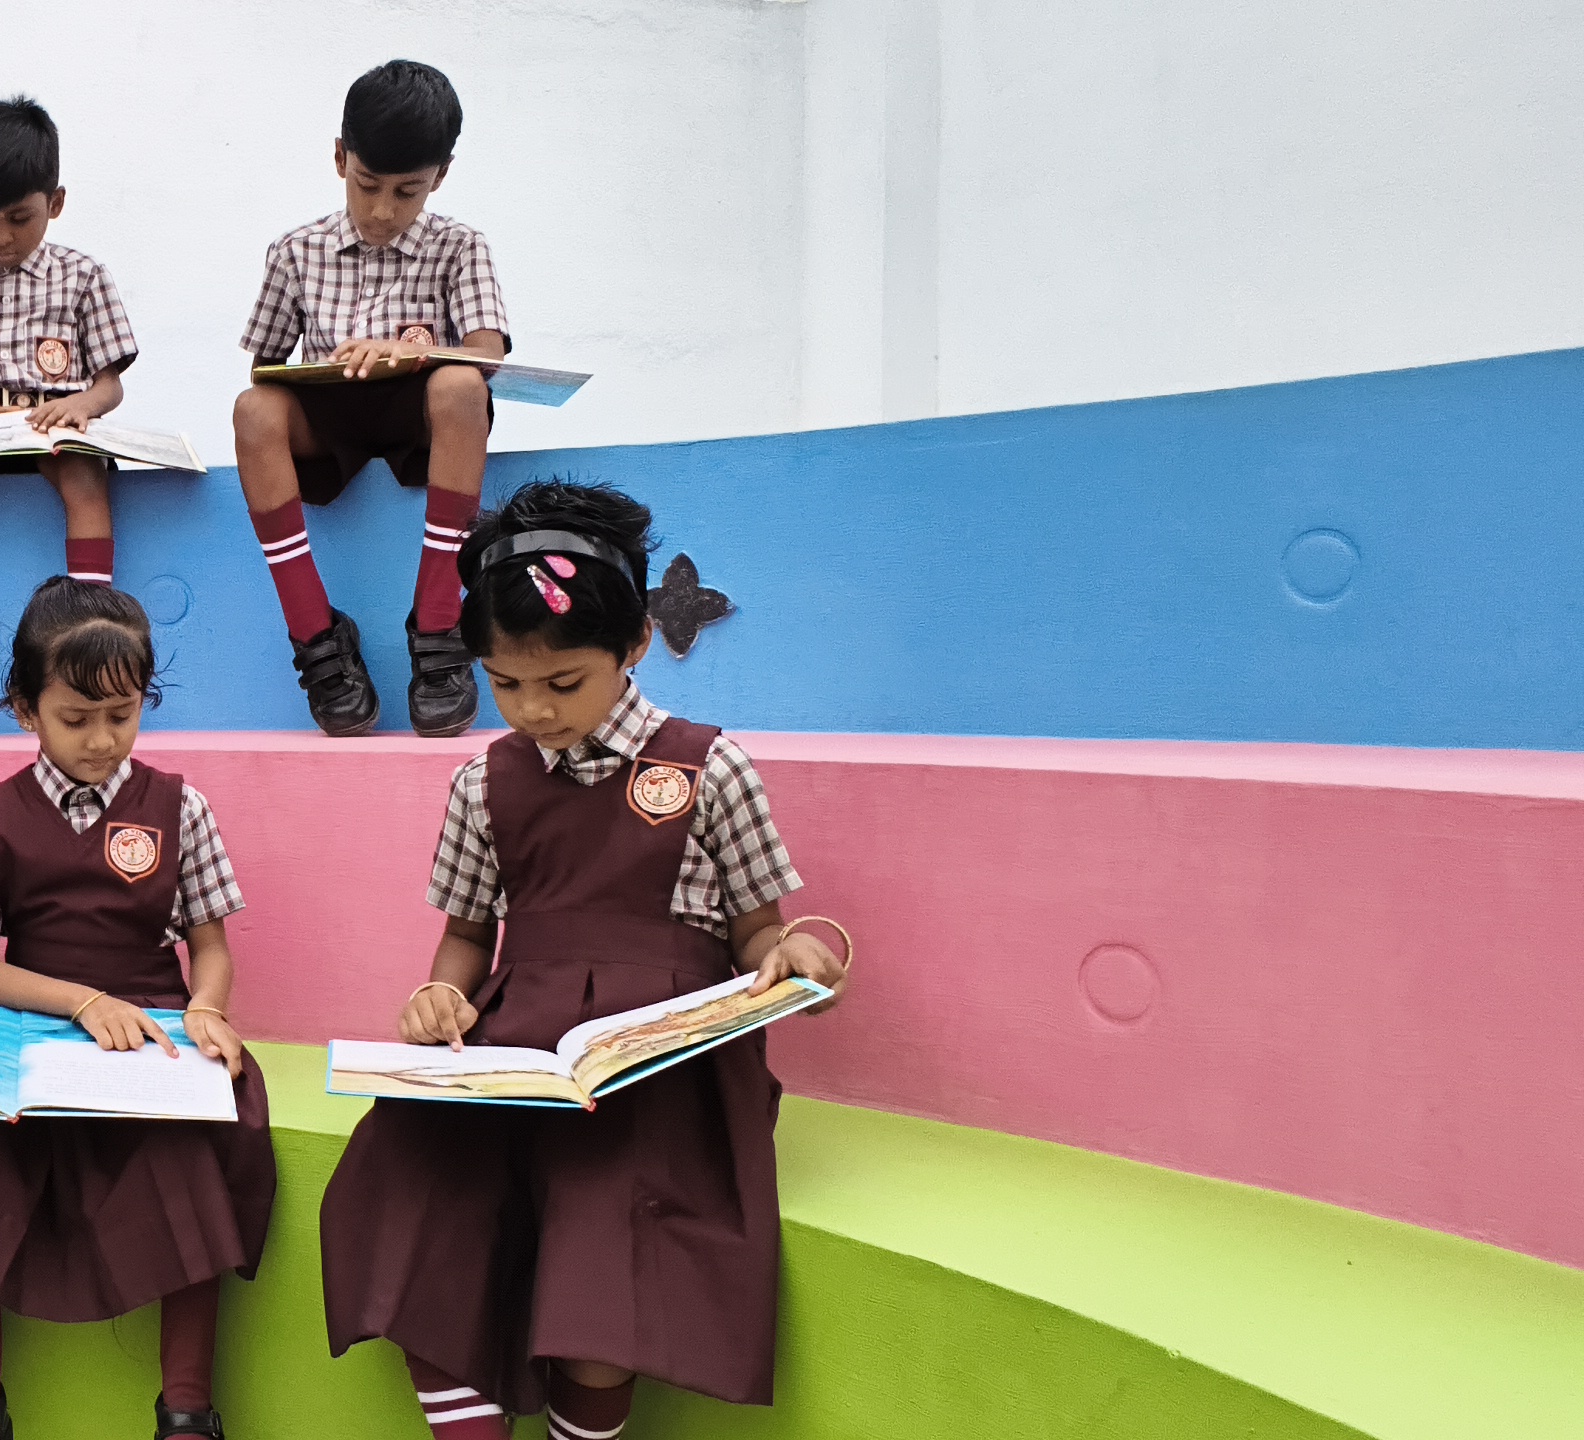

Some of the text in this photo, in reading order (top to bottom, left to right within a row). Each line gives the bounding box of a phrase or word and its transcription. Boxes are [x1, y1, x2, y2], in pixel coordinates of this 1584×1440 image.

[635, 767, 687, 798] VIDHYA VIKASHNI
[111, 829, 154, 857] VIDHYA VIKASHNI
